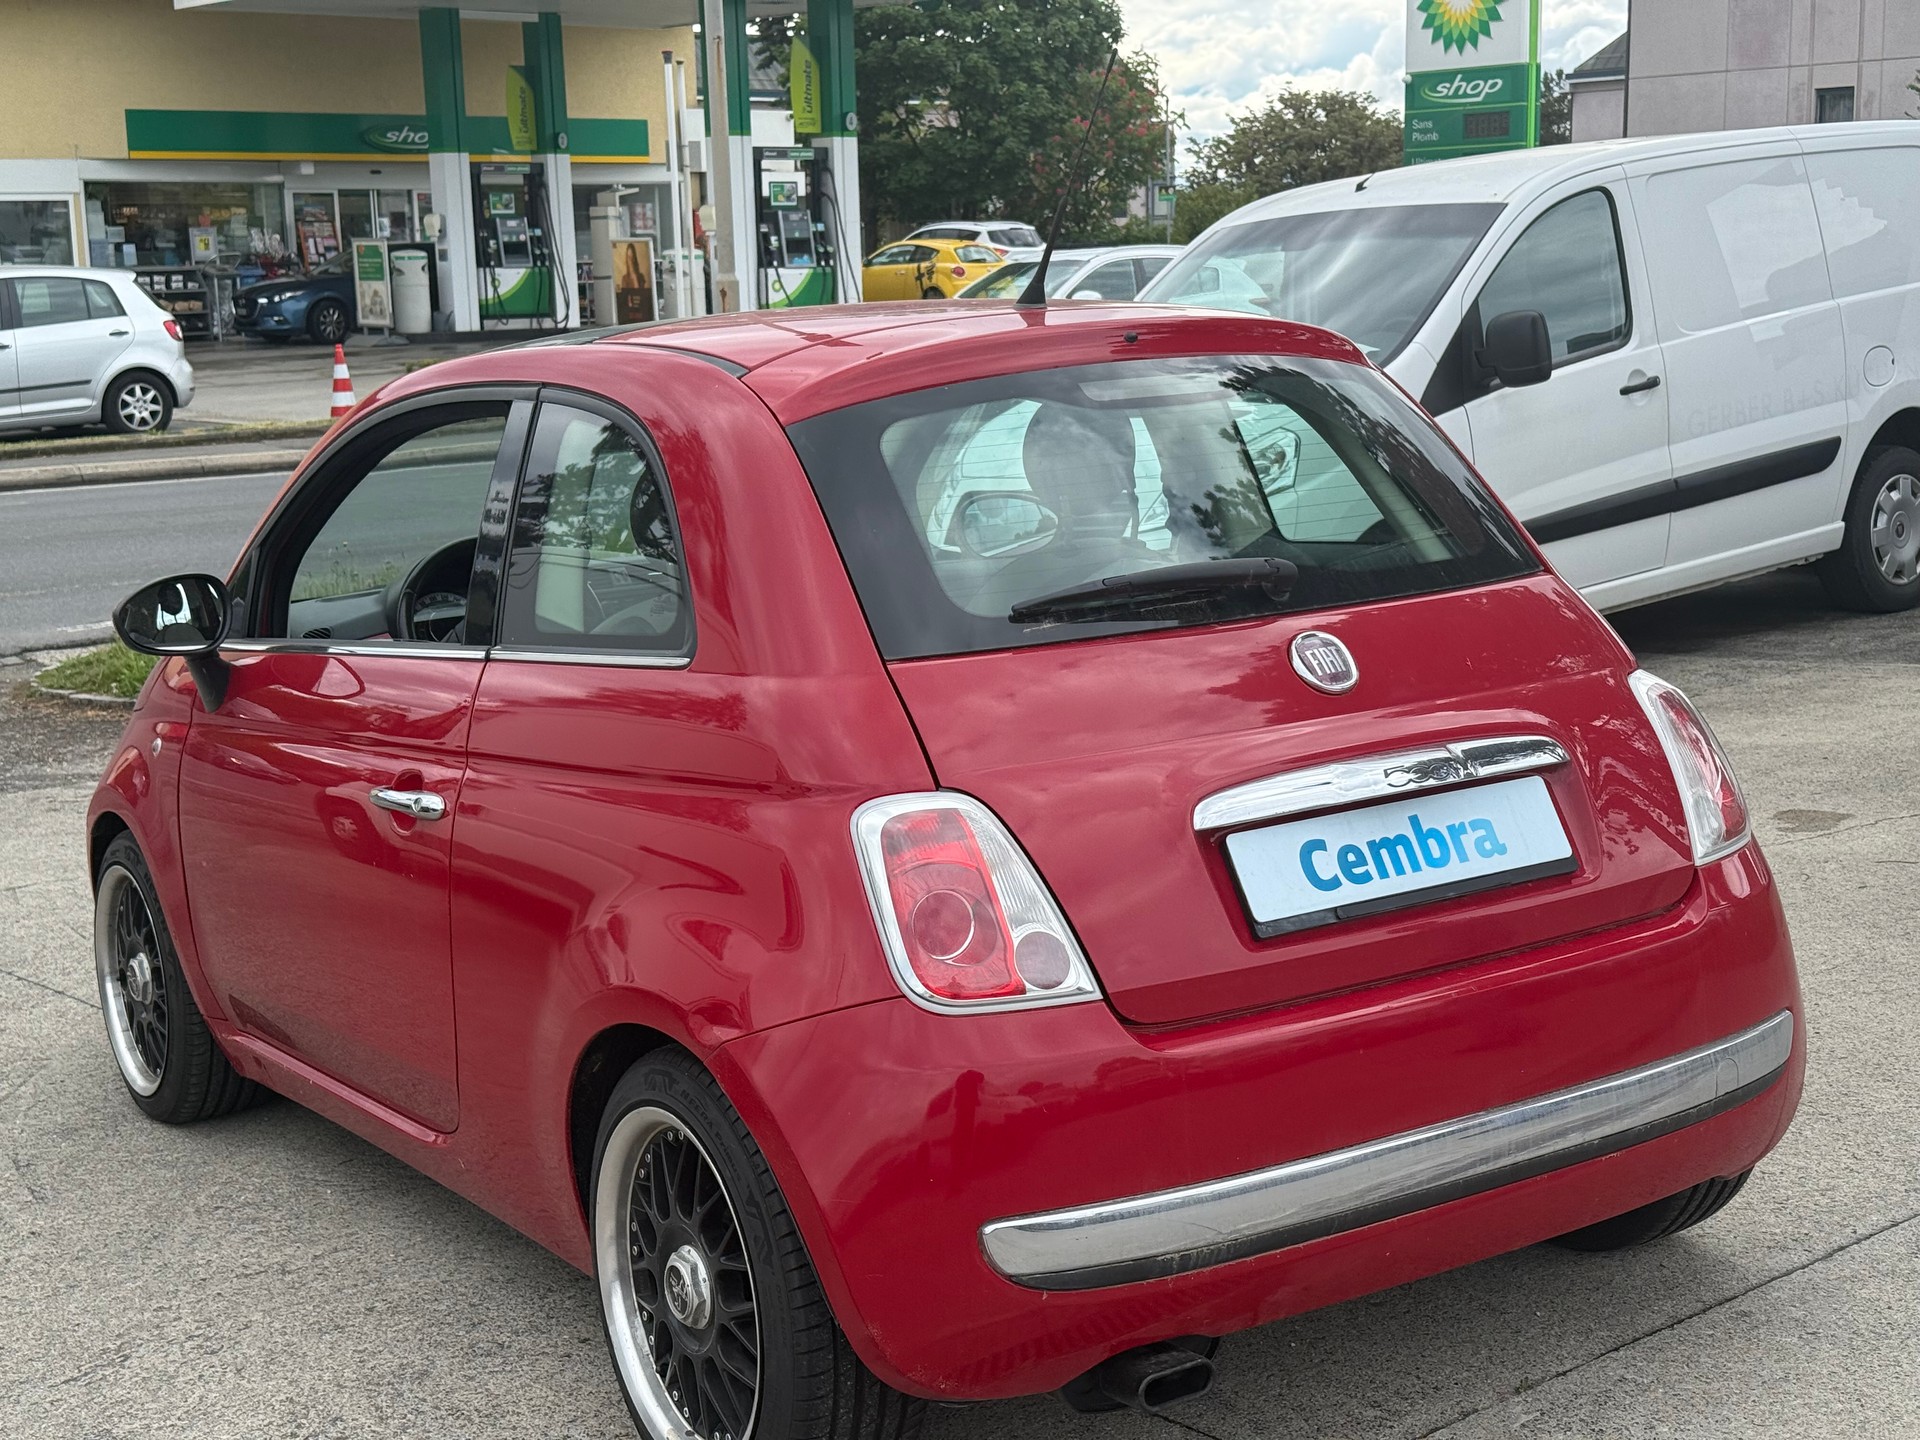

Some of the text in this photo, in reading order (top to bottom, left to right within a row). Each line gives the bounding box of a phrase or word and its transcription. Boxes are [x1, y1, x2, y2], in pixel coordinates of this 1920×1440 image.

[1435, 74, 1502, 101] shop
[386, 125, 429, 144] sho
[1412, 119, 1433, 129] Sans
[1412, 131, 1439, 142] Plomb
[1304, 645, 1347, 677] FIAT
[1383, 762, 1452, 788] 500
[1299, 814, 1507, 892] Cembra
